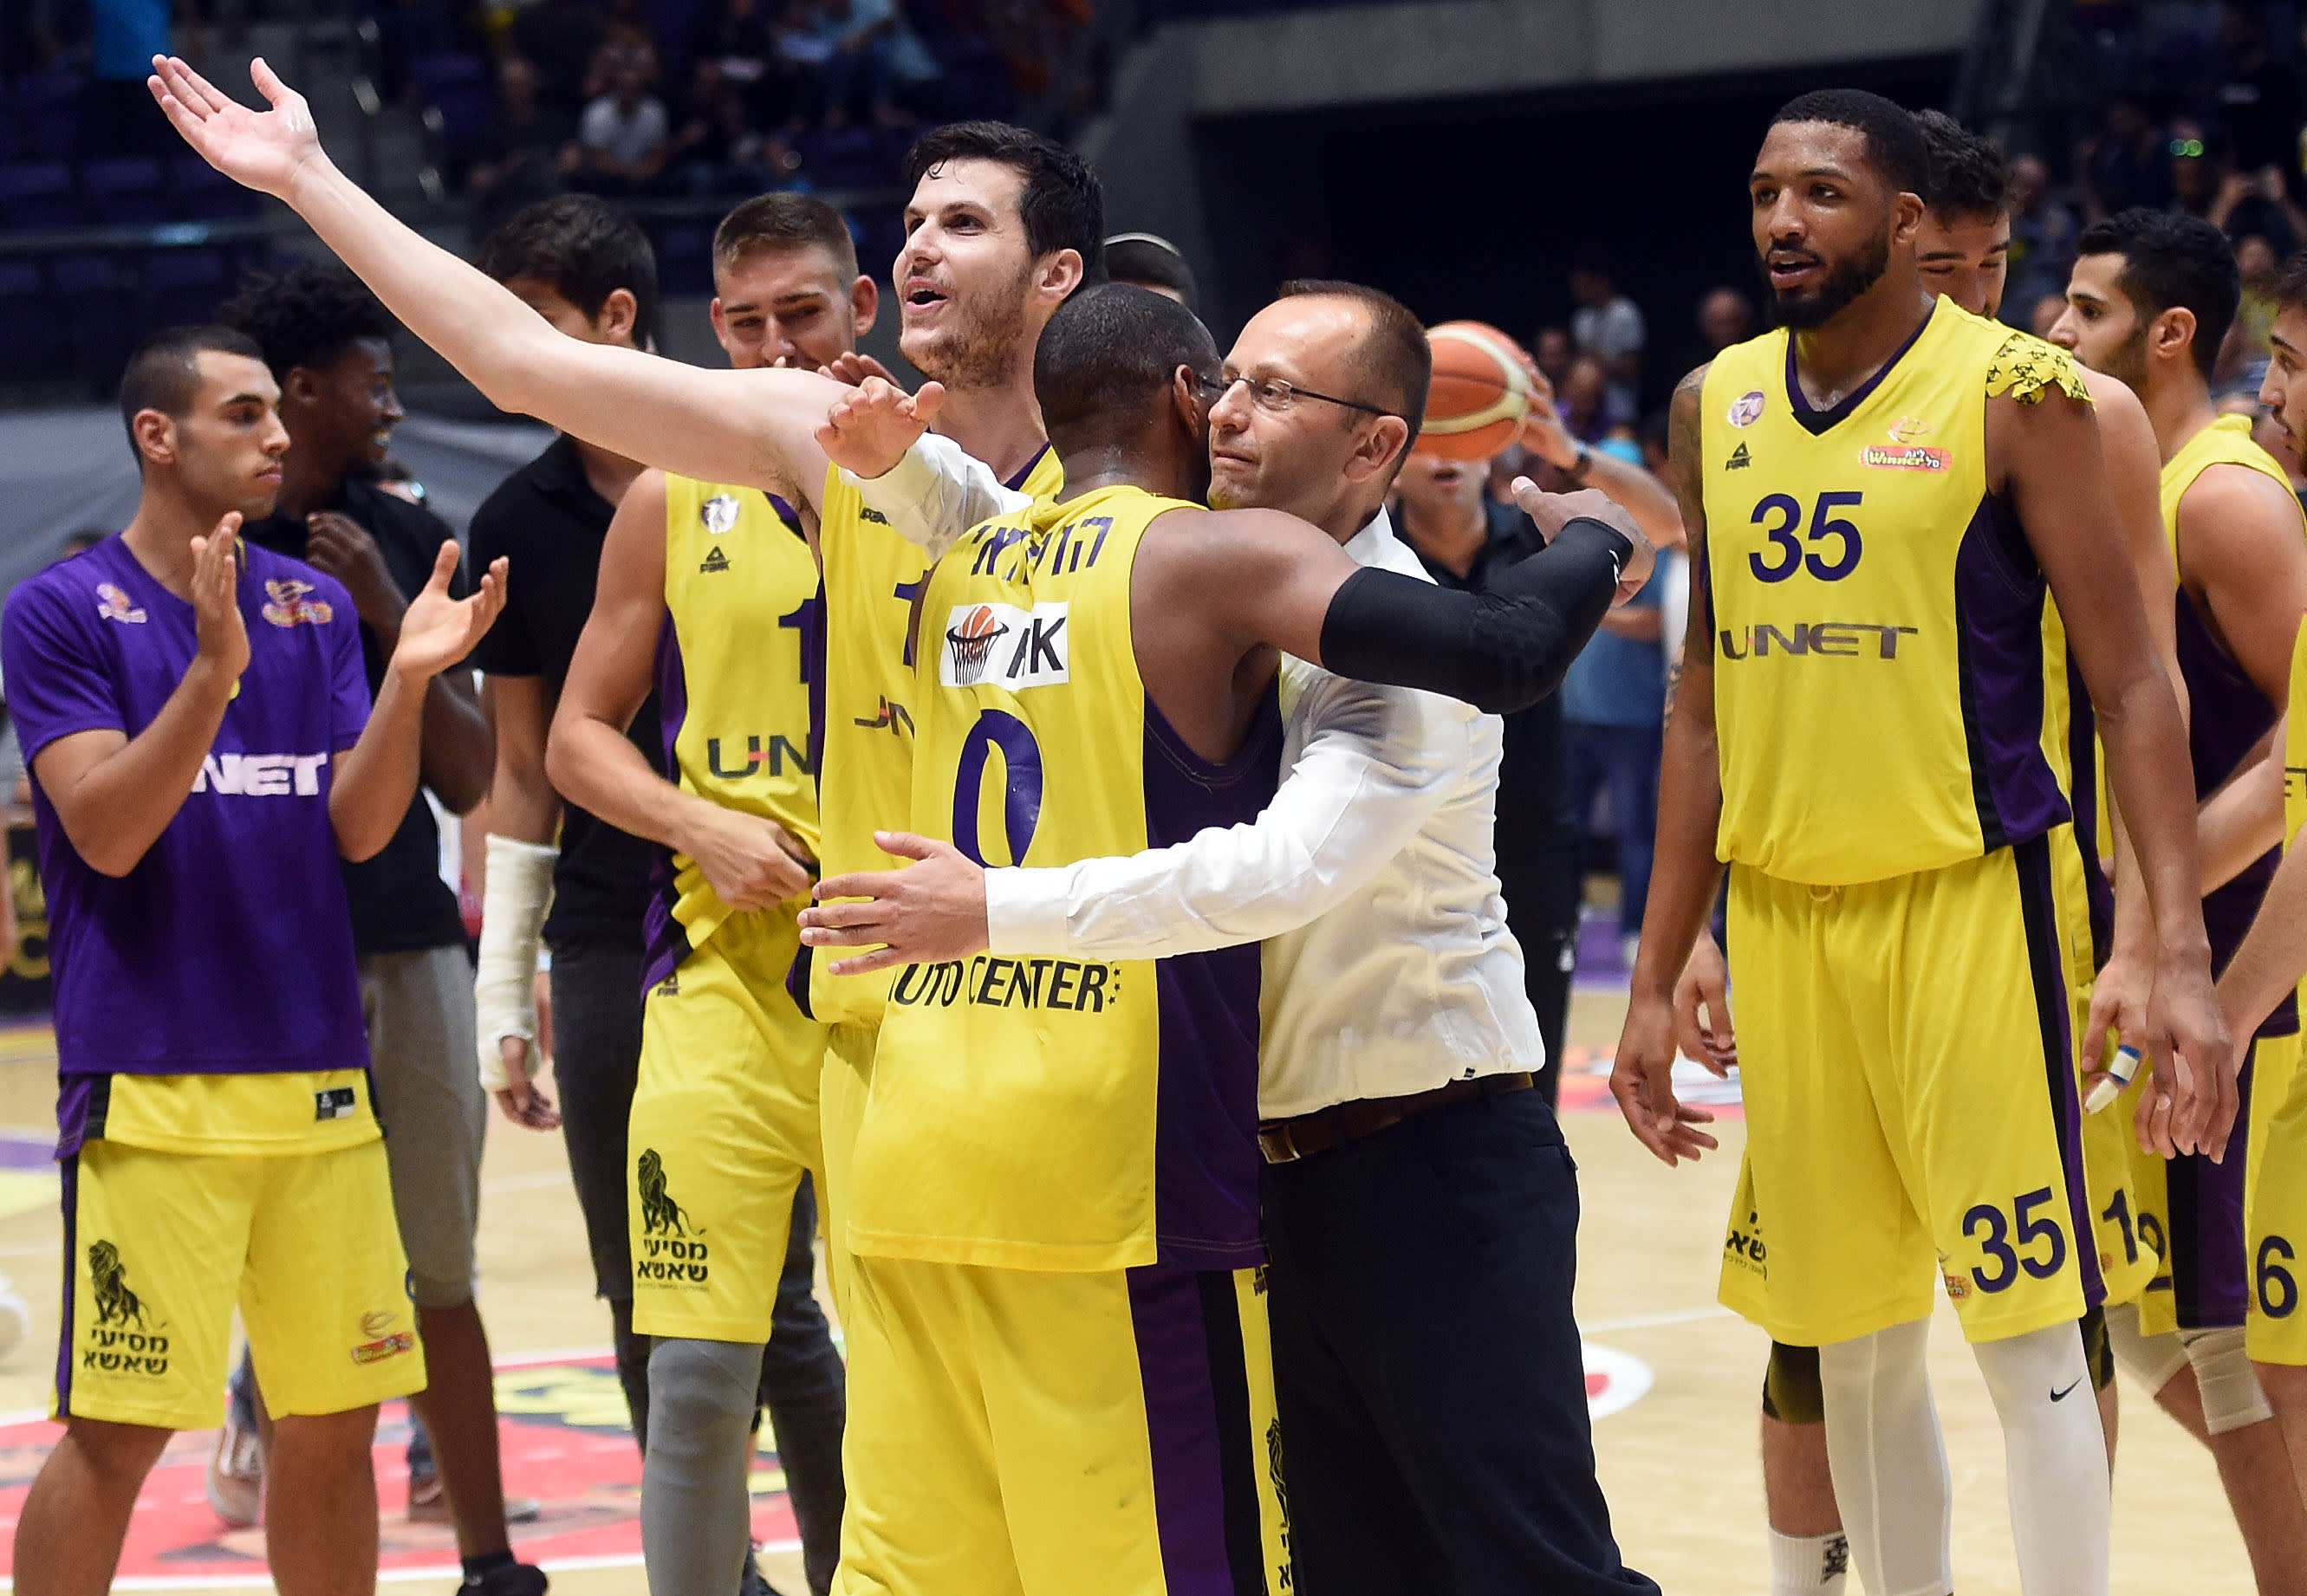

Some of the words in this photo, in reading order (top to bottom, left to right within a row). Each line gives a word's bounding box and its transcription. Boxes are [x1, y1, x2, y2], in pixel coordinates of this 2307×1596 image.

[1749, 491, 1862, 583] 35
[1719, 622, 1918, 660] UNET
[192, 752, 328, 796] NET
[707, 735, 815, 779] UN
[952, 709, 1043, 868] 0
[888, 959, 964, 1007] UTO
[968, 956, 1108, 1013] CENTER
[1962, 1186, 2066, 1293] 35
[2257, 1236, 2297, 1318] 6
